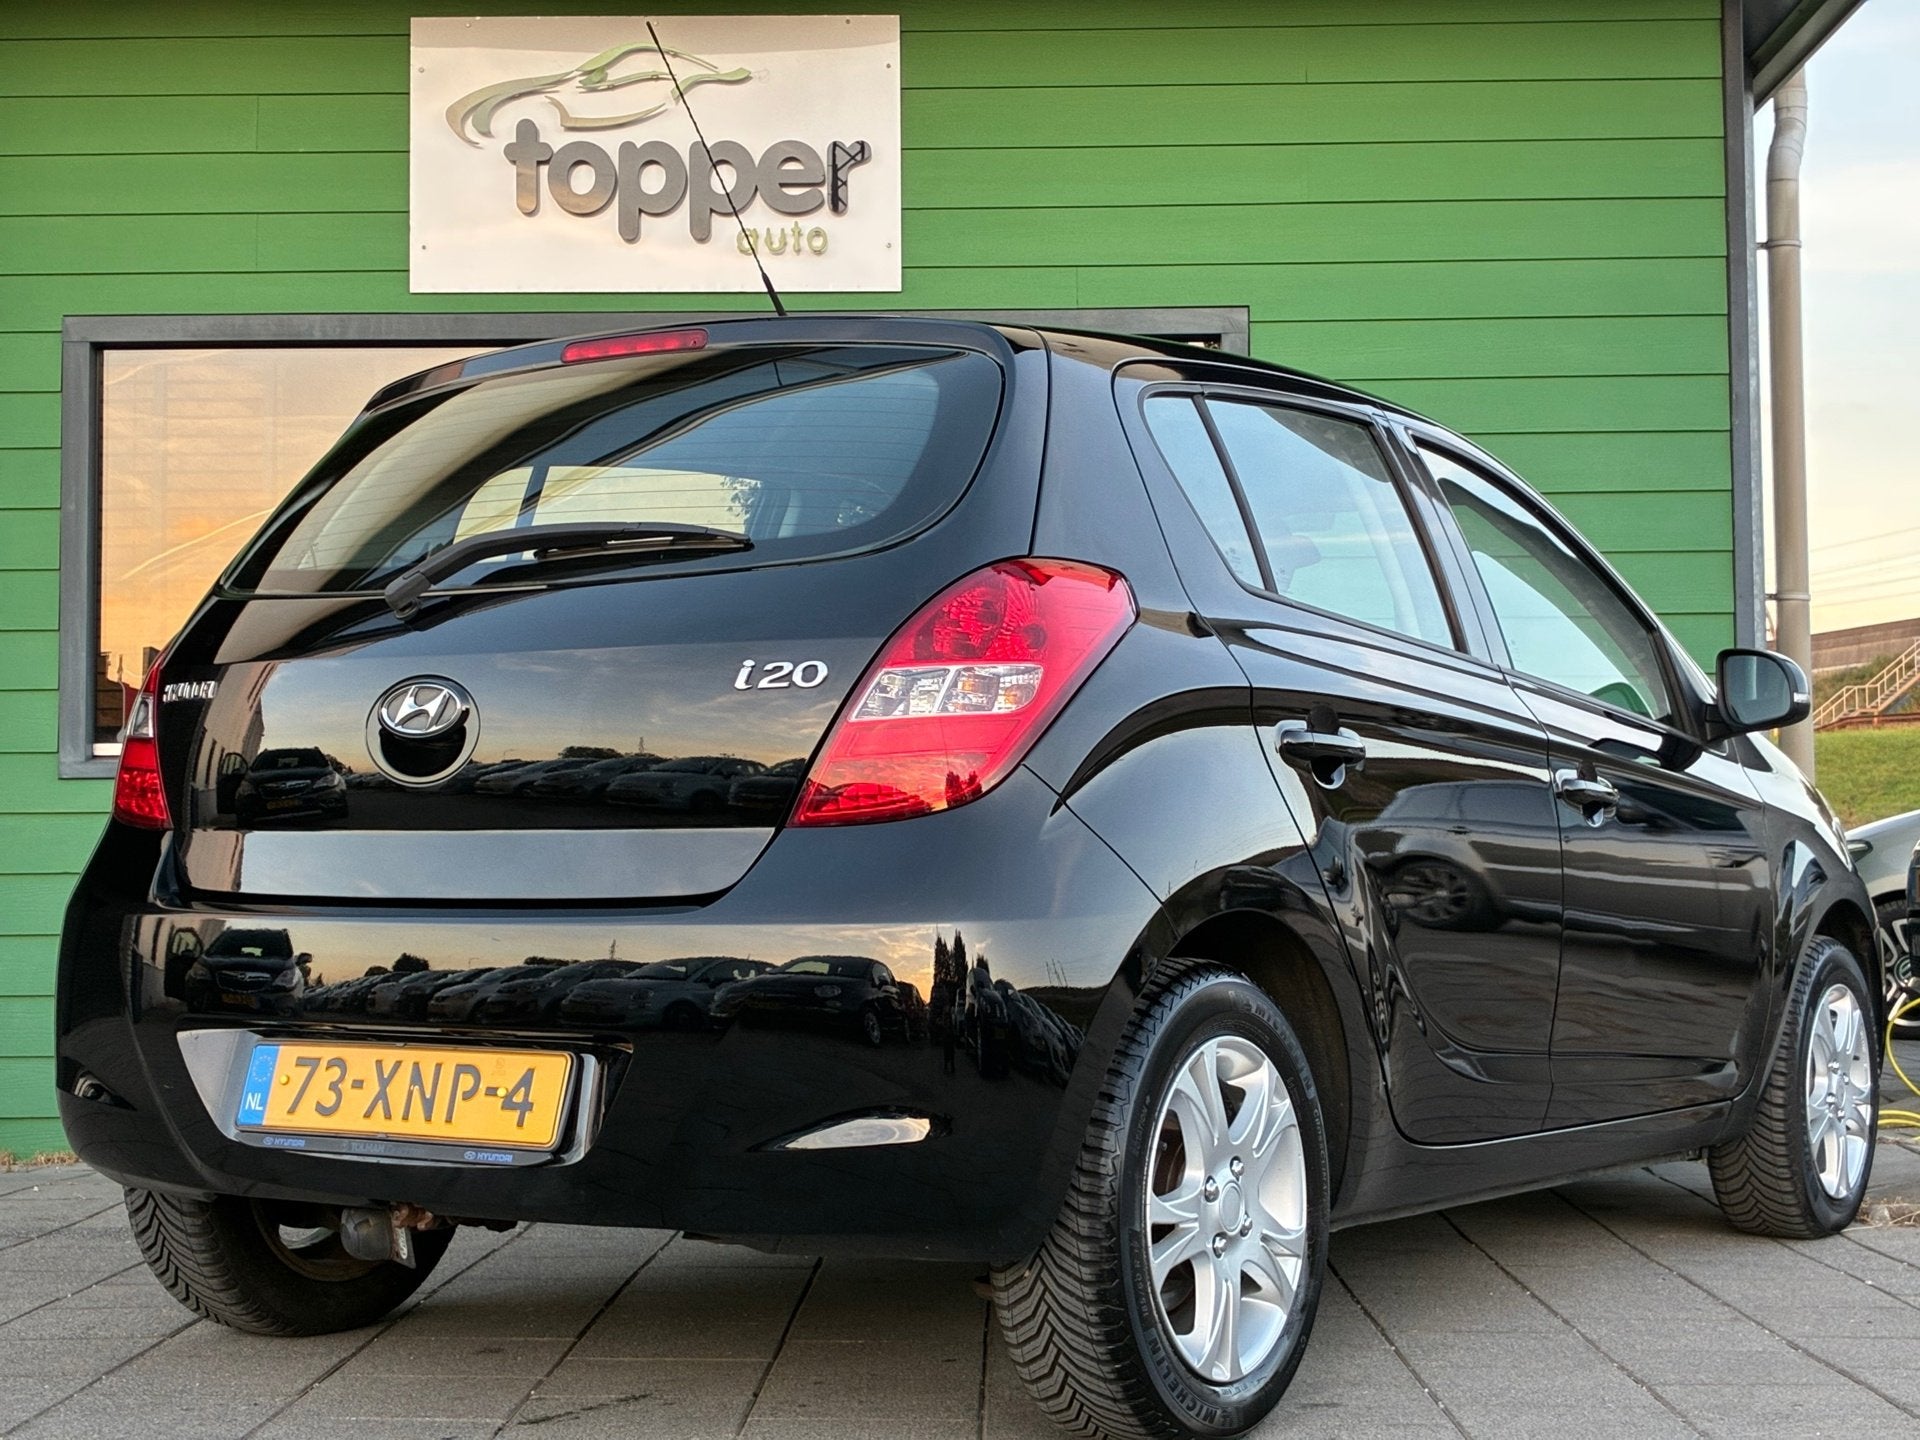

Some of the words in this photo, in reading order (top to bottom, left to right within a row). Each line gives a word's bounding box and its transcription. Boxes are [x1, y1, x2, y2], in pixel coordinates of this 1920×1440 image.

[503, 118, 872, 243] topper
[736, 221, 829, 256] auto
[734, 659, 829, 691] i20
[245, 1092, 264, 1111] NL
[287, 1056, 535, 1128] 73-XNP-4
[1148, 1335, 1220, 1425] MICHELIN
